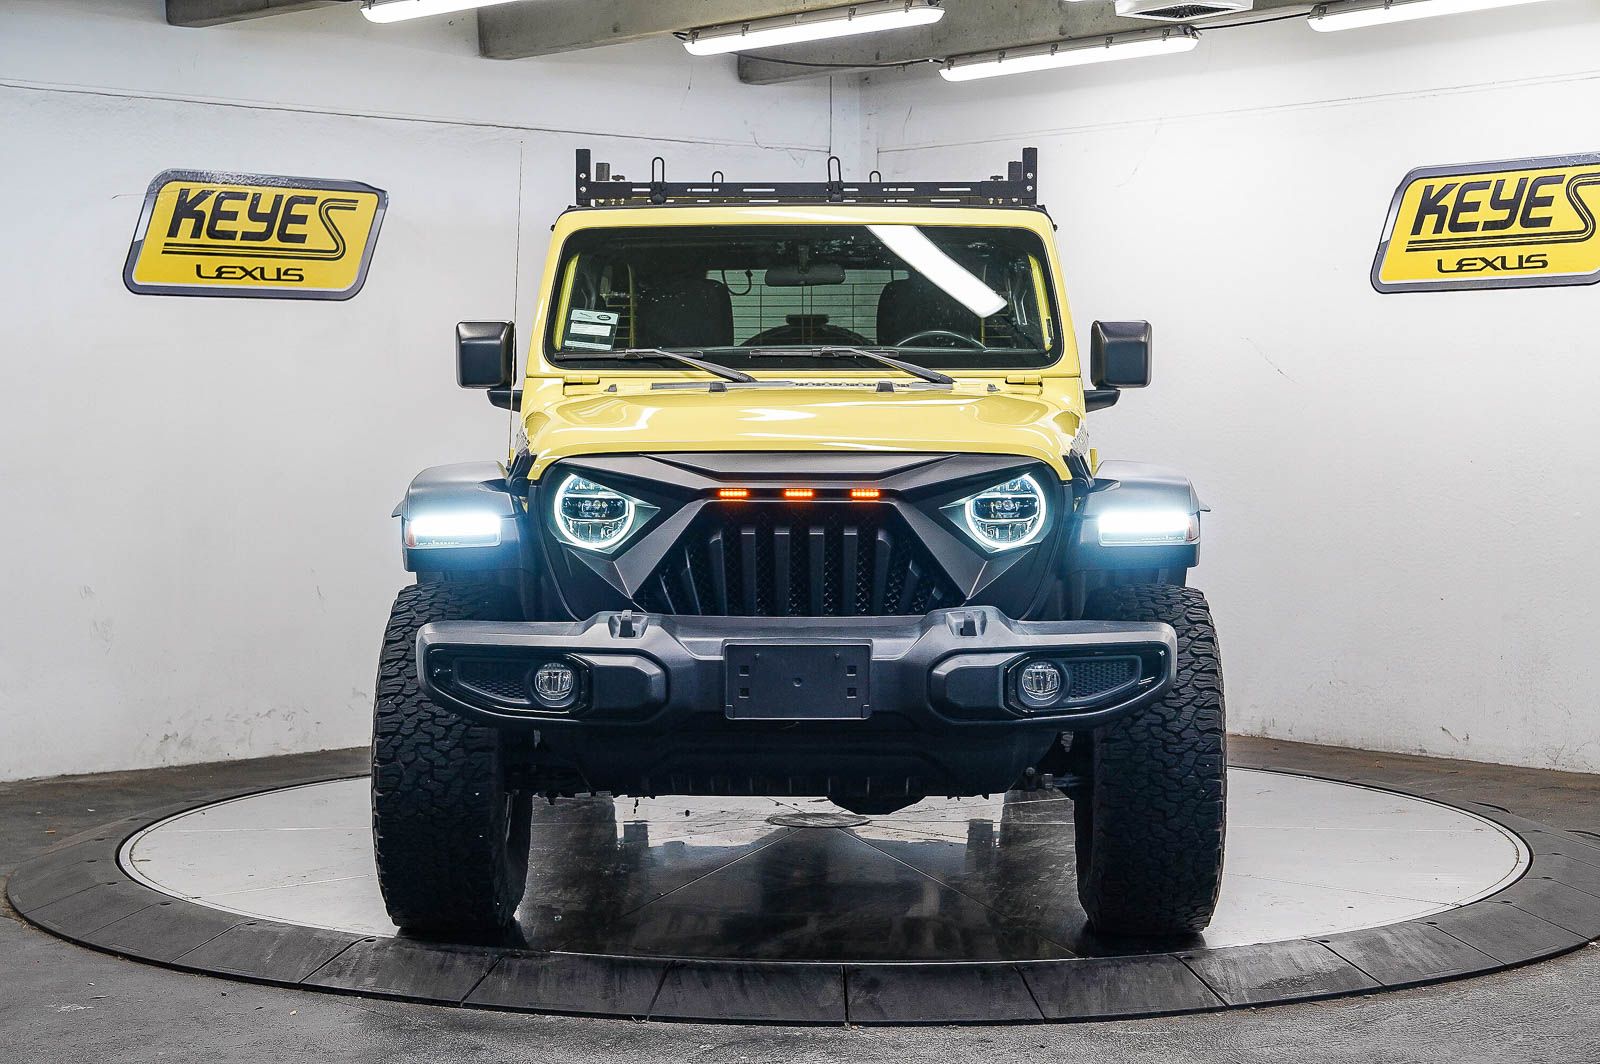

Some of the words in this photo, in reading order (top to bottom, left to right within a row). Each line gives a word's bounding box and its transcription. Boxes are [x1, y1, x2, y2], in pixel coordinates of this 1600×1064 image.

[166, 188, 359, 258] KEYES
[1410, 173, 1600, 243] KEYES
[195, 263, 305, 283] LEXUS
[1437, 253, 1549, 274] LEXUS
